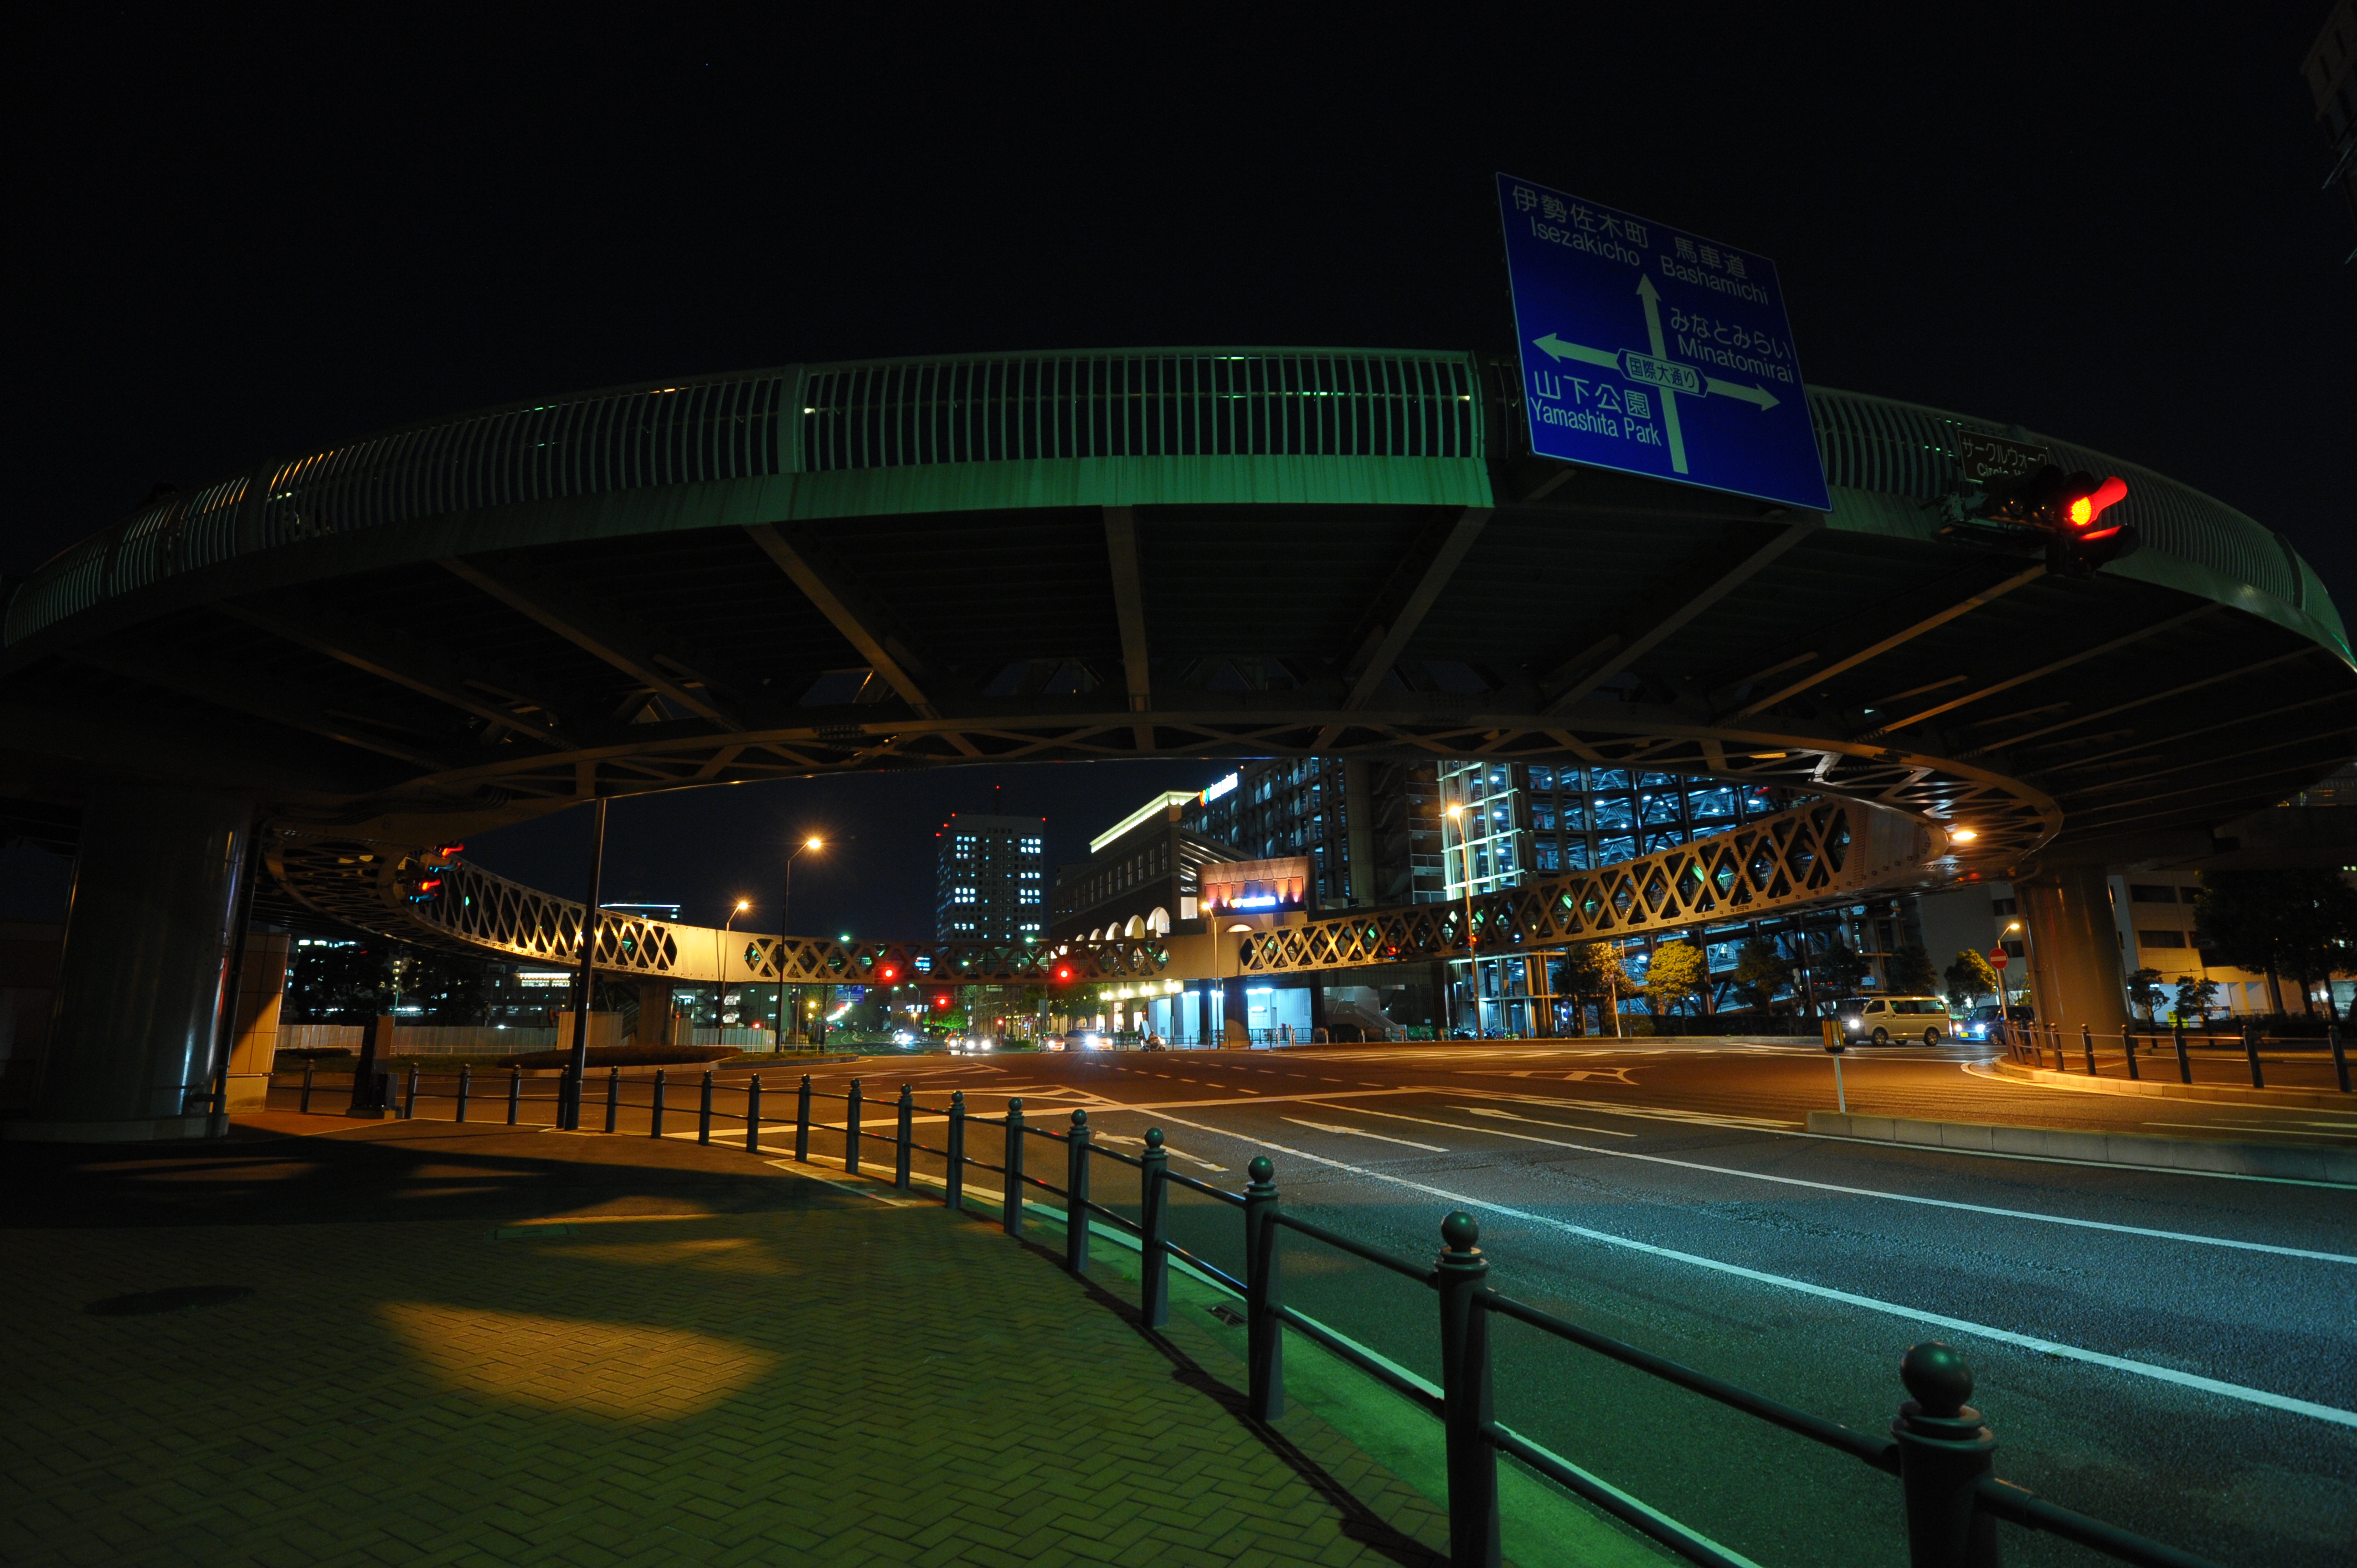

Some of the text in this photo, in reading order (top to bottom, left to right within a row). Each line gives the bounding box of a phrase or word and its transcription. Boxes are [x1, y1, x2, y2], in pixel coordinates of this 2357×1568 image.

[1512, 184, 1748, 279] 伊勢佐木町 馬車道
[1530, 216, 1769, 305] Isezakicho Bashamichi
[1670, 307, 1792, 359] みなとみらい
[1629, 357, 1695, 388] 国際大通り
[1677, 334, 1794, 384] Minatomirai
[1534, 370, 1651, 419] 山下公園
[1530, 396, 1662, 446] Yamashita Park
[1962, 437, 2047, 469] サークルウォーク
